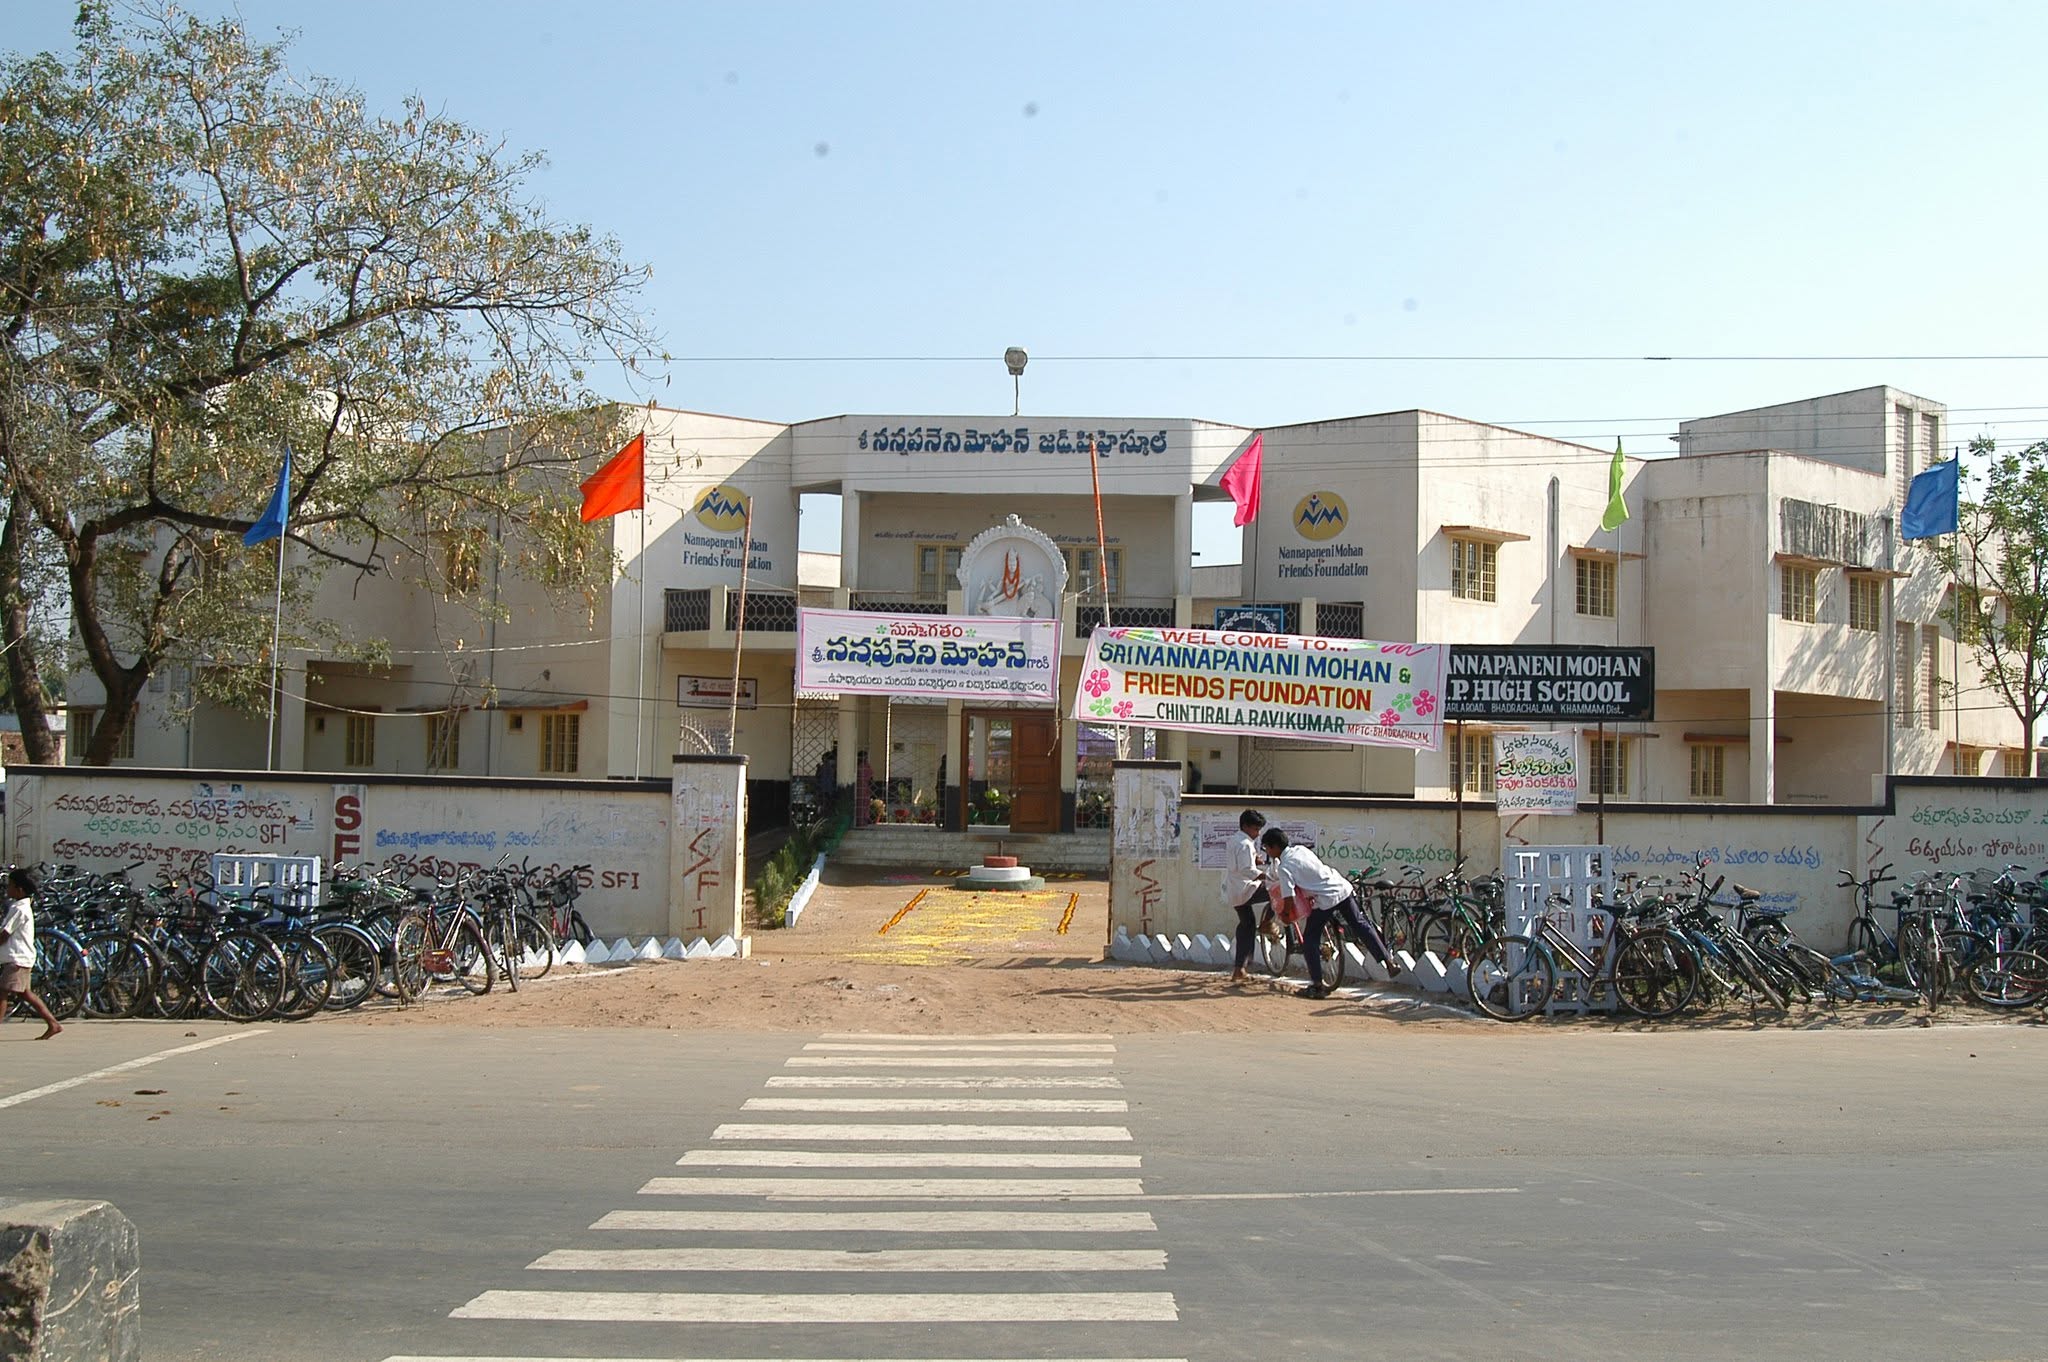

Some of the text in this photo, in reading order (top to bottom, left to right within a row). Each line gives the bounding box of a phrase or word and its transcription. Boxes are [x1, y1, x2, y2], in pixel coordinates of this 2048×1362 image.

[684, 532, 737, 550] Nannapaneni
[683, 551, 772, 570] Friends Founation
[1279, 544, 1363, 561] Nannapaneni Mohan
[1279, 562, 1368, 578] Friends Foundation
[890, 622, 963, 638] సుస్వాగతం
[1160, 629, 1348, 652] WEL COME TO...
[1099, 642, 1411, 684] SRI NANNAPANANI MOHAN &
[1566, 655, 1641, 677] MOHAN
[1124, 671, 1372, 712] FRIENDS FOUNDATION
[1472, 679, 1532, 701] HIGH
[1538, 680, 1630, 703] SCHOOL
[1156, 702, 1245, 727] CHINTIRALA
[260, 824, 286, 845] SFI
[601, 871, 640, 890] SFI
